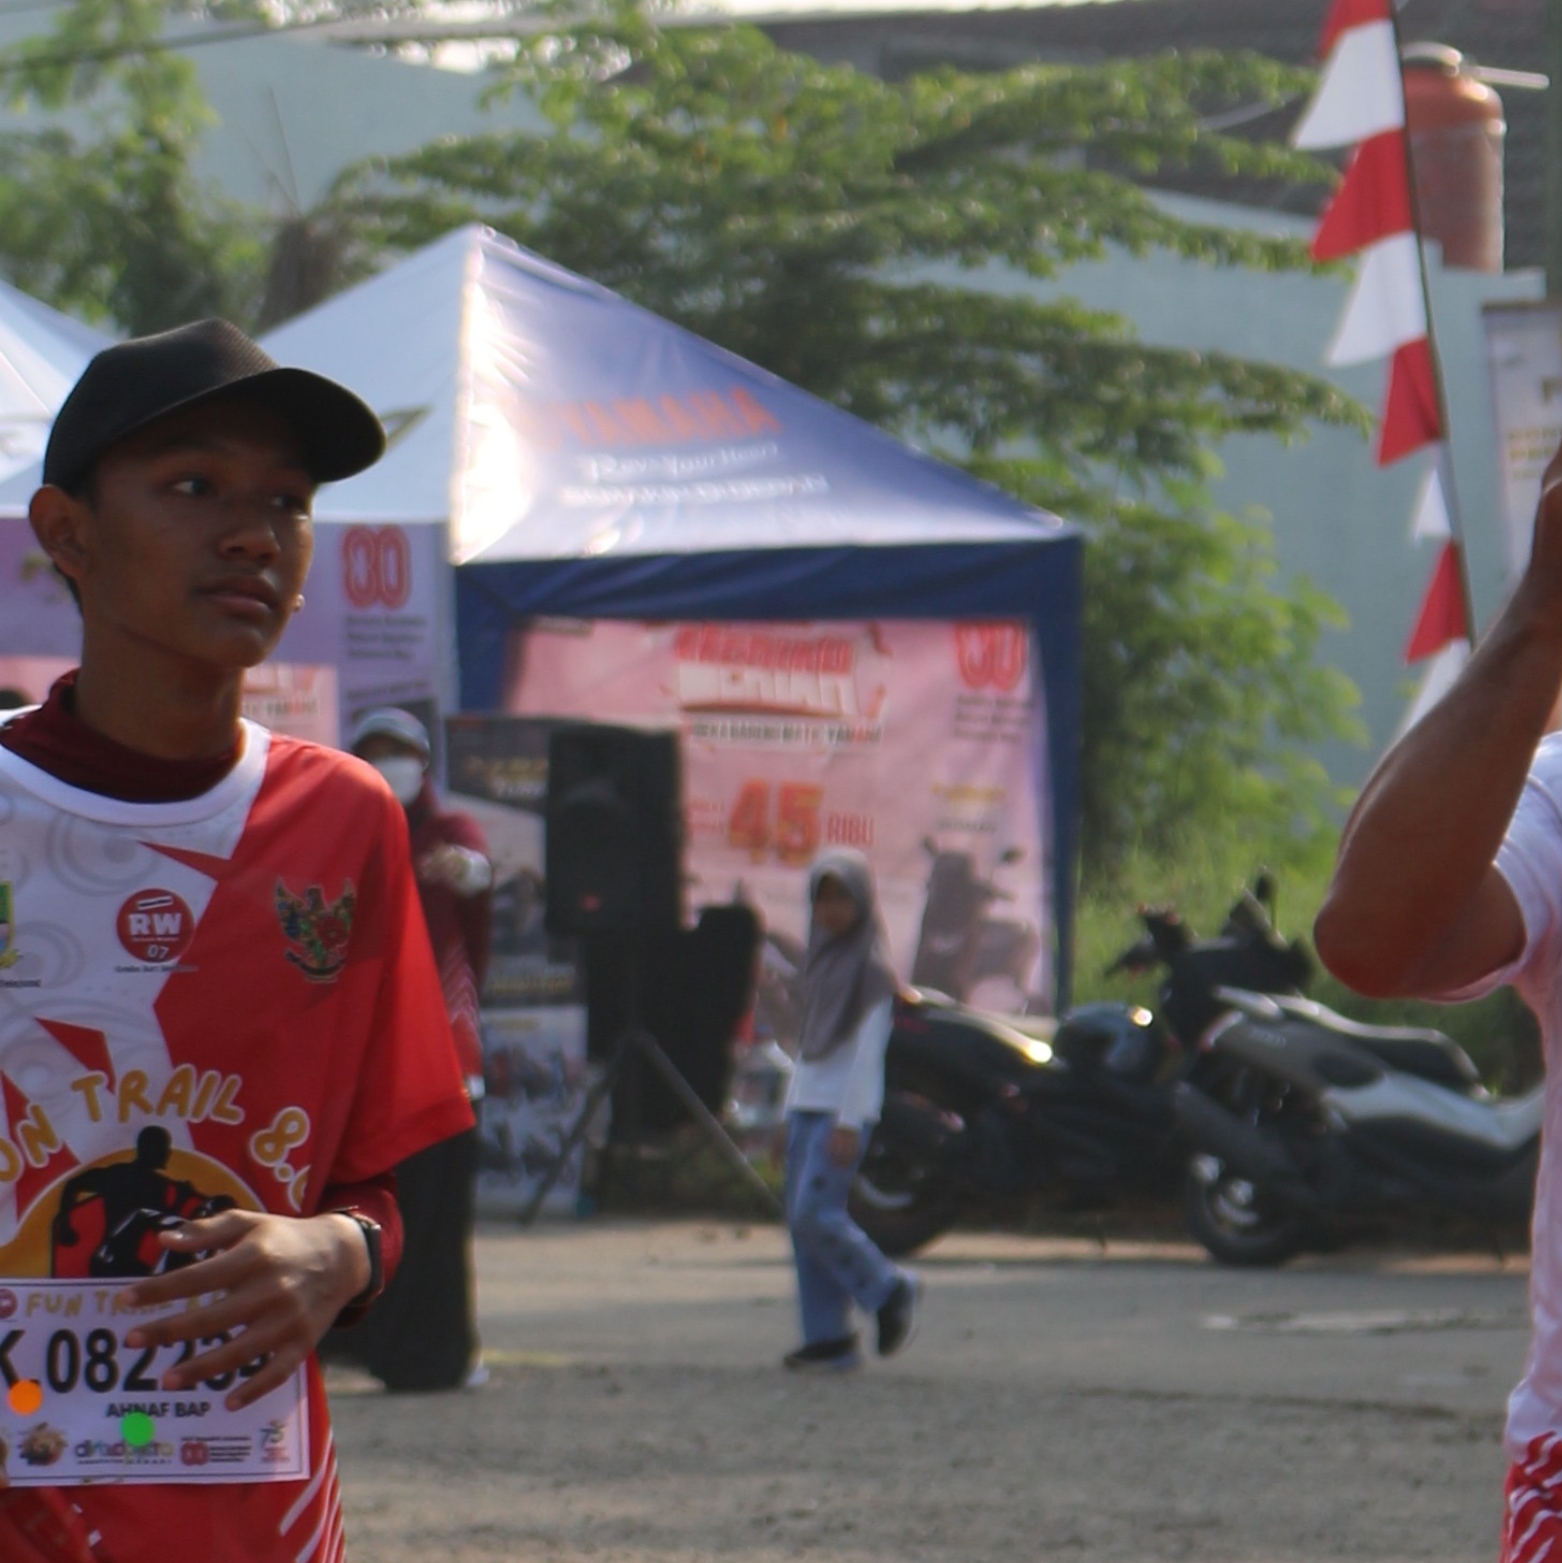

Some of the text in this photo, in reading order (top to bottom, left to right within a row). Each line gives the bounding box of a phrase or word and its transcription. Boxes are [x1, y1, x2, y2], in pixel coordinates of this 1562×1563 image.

[556, 384, 784, 446] YAMAHA
[729, 779, 824, 869] 45
[128, 911, 182, 936] RW
[148, 944, 170, 959] 07
[70, 1063, 245, 1125] TRAIL
[25, 1292, 83, 1318] FUN
[174, 1402, 211, 1418] BAP
